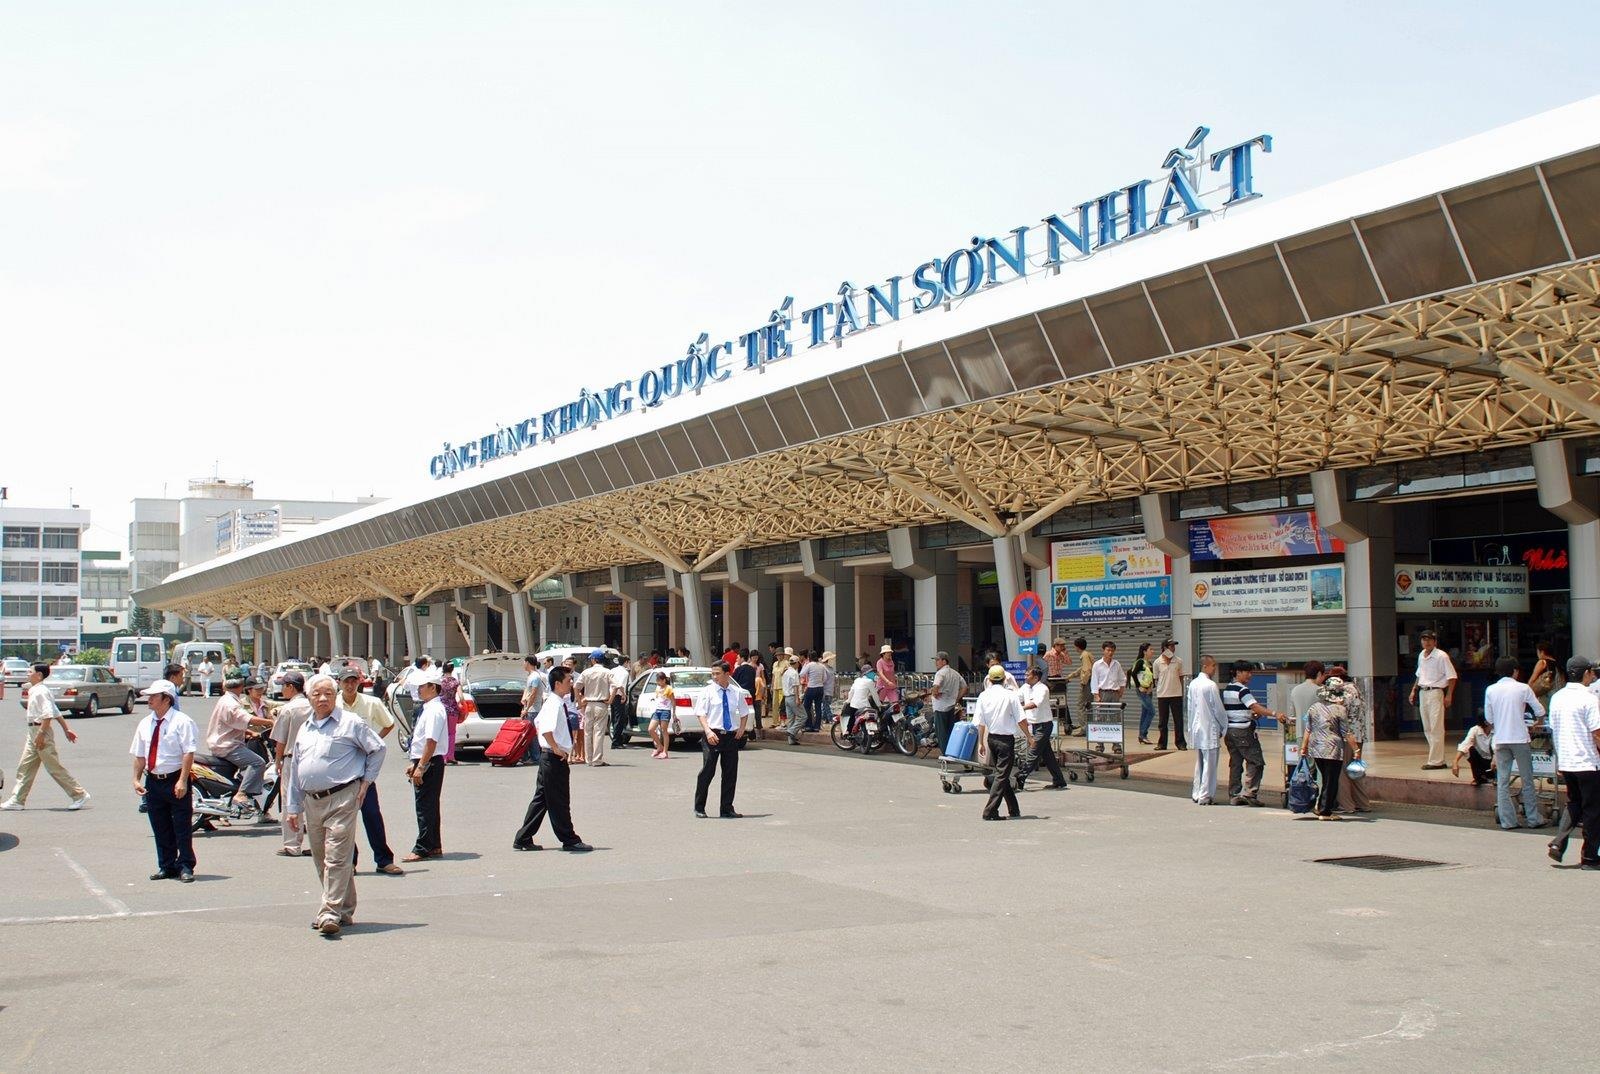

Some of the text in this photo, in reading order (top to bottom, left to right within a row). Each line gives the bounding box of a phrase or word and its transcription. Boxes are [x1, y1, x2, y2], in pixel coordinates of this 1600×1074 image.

[430, 126, 1273, 480] CẢNG HÀNG KHÔNG QUỐC TẾ TÂN SƠN NHẤT
[1078, 594, 1146, 608] AGRIBANK
